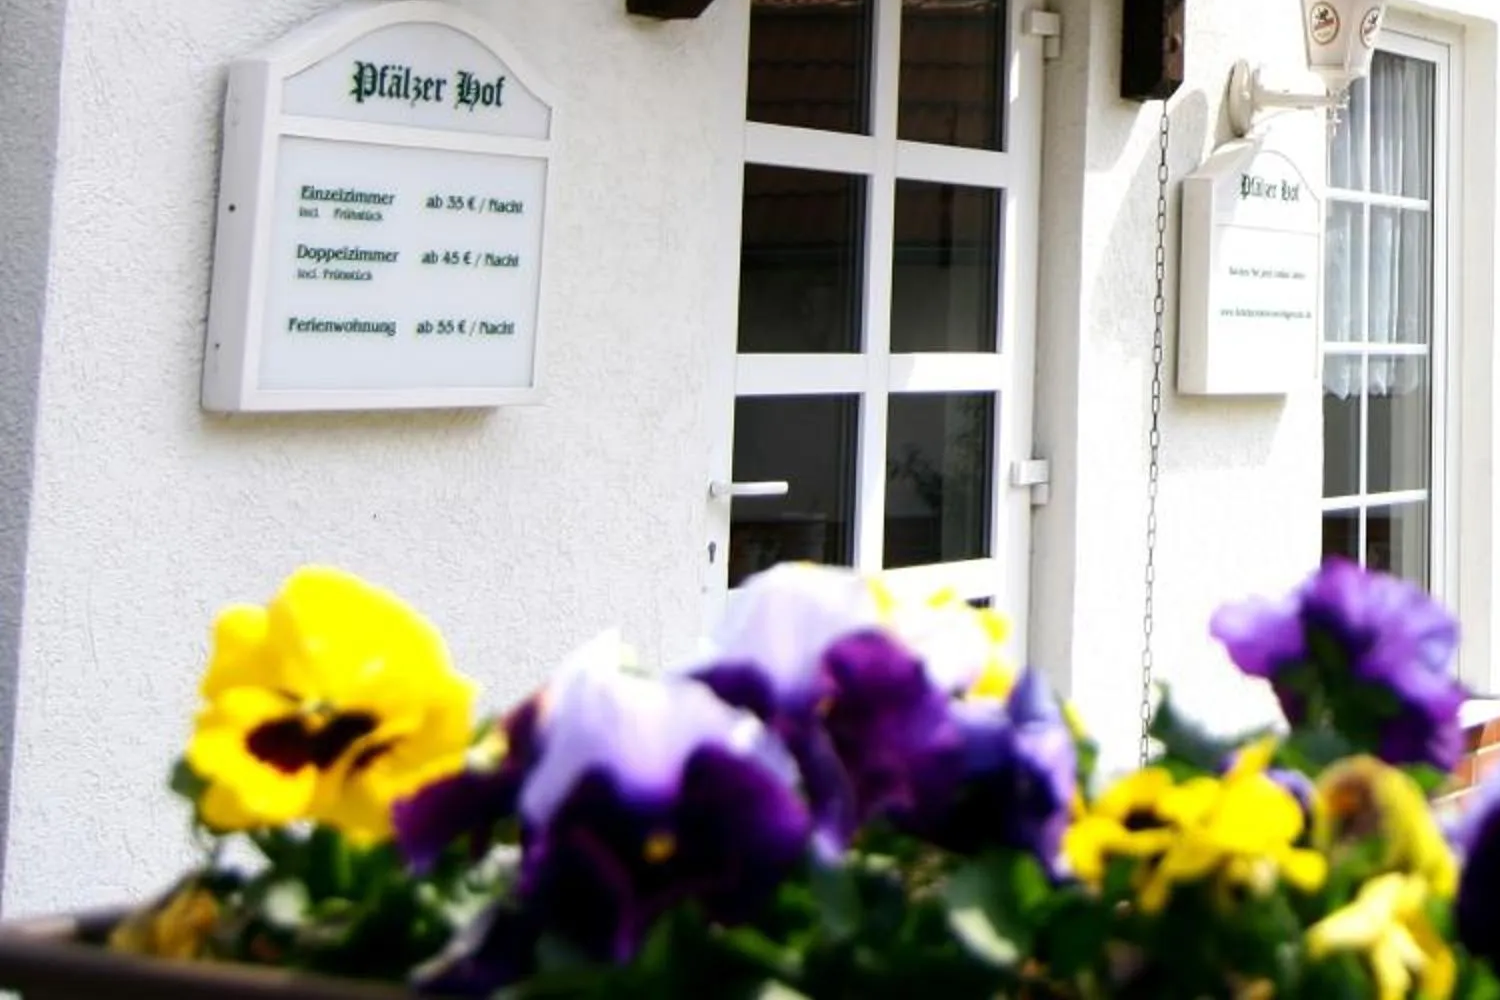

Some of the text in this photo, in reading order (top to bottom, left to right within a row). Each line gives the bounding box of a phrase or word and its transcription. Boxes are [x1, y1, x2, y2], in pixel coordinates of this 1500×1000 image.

[349, 60, 506, 112] Pfälzer Hof
[301, 185, 396, 206] Einzelzimmer
[425, 194, 443, 209] ab
[466, 196, 477, 211] €
[478, 198, 487, 214] /
[488, 197, 524, 214] Nacht
[297, 243, 520, 268] Doppelzimmer ab 45 € / Nacht
[288, 316, 397, 336] Ferienwohnung
[416, 320, 433, 335] ab
[456, 319, 467, 335] €
[468, 320, 478, 337] /
[478, 321, 515, 336] Nacht
